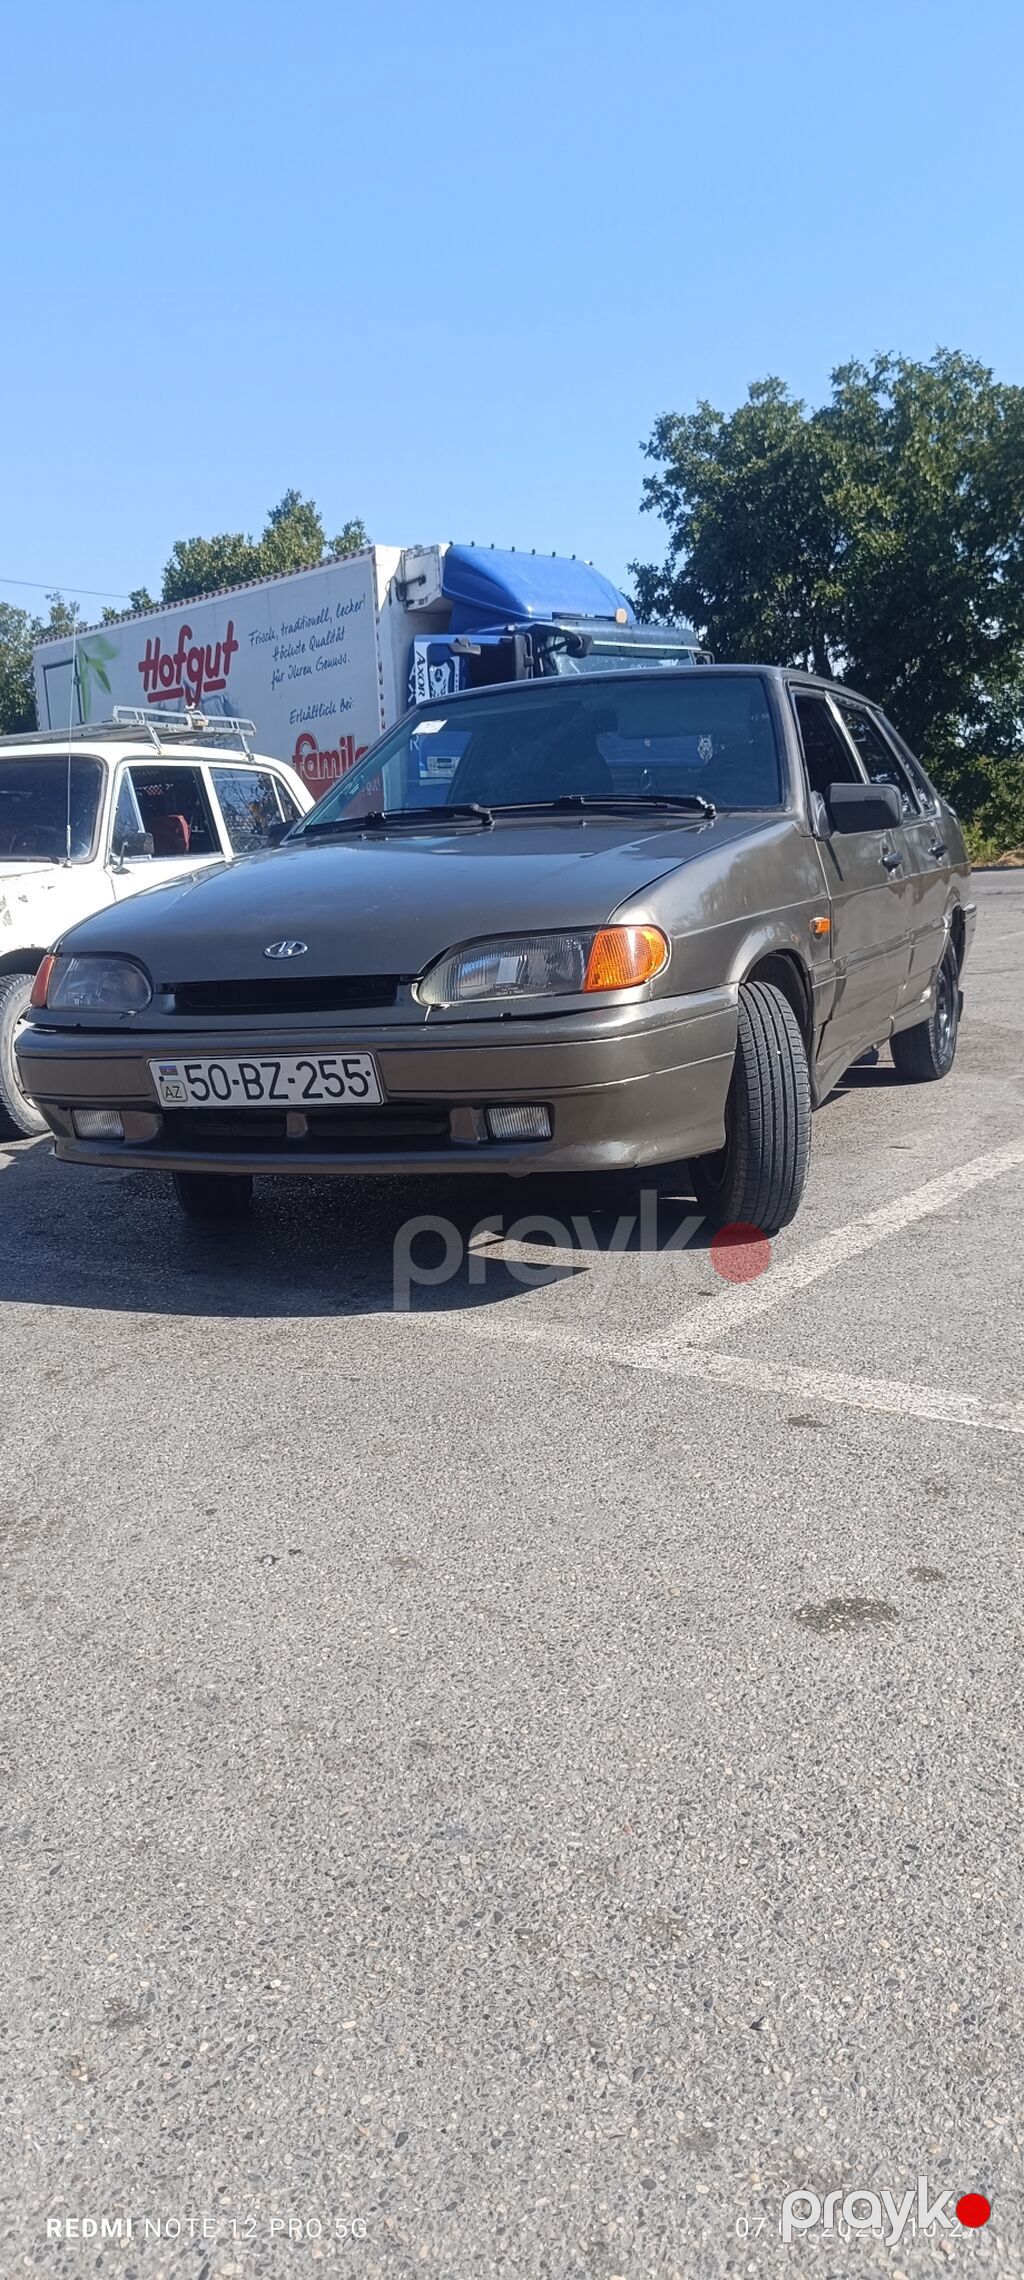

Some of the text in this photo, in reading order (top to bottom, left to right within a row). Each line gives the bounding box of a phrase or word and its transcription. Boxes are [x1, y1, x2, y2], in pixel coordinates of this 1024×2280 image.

[336, 593, 366, 618] lecker!
[309, 626, 345, 652] Qualität
[138, 620, 238, 709] Hofgut
[271, 669, 285, 691] für
[416, 651, 426, 698] AXOR
[164, 1058, 370, 1102] AZ 50-BZ-255
